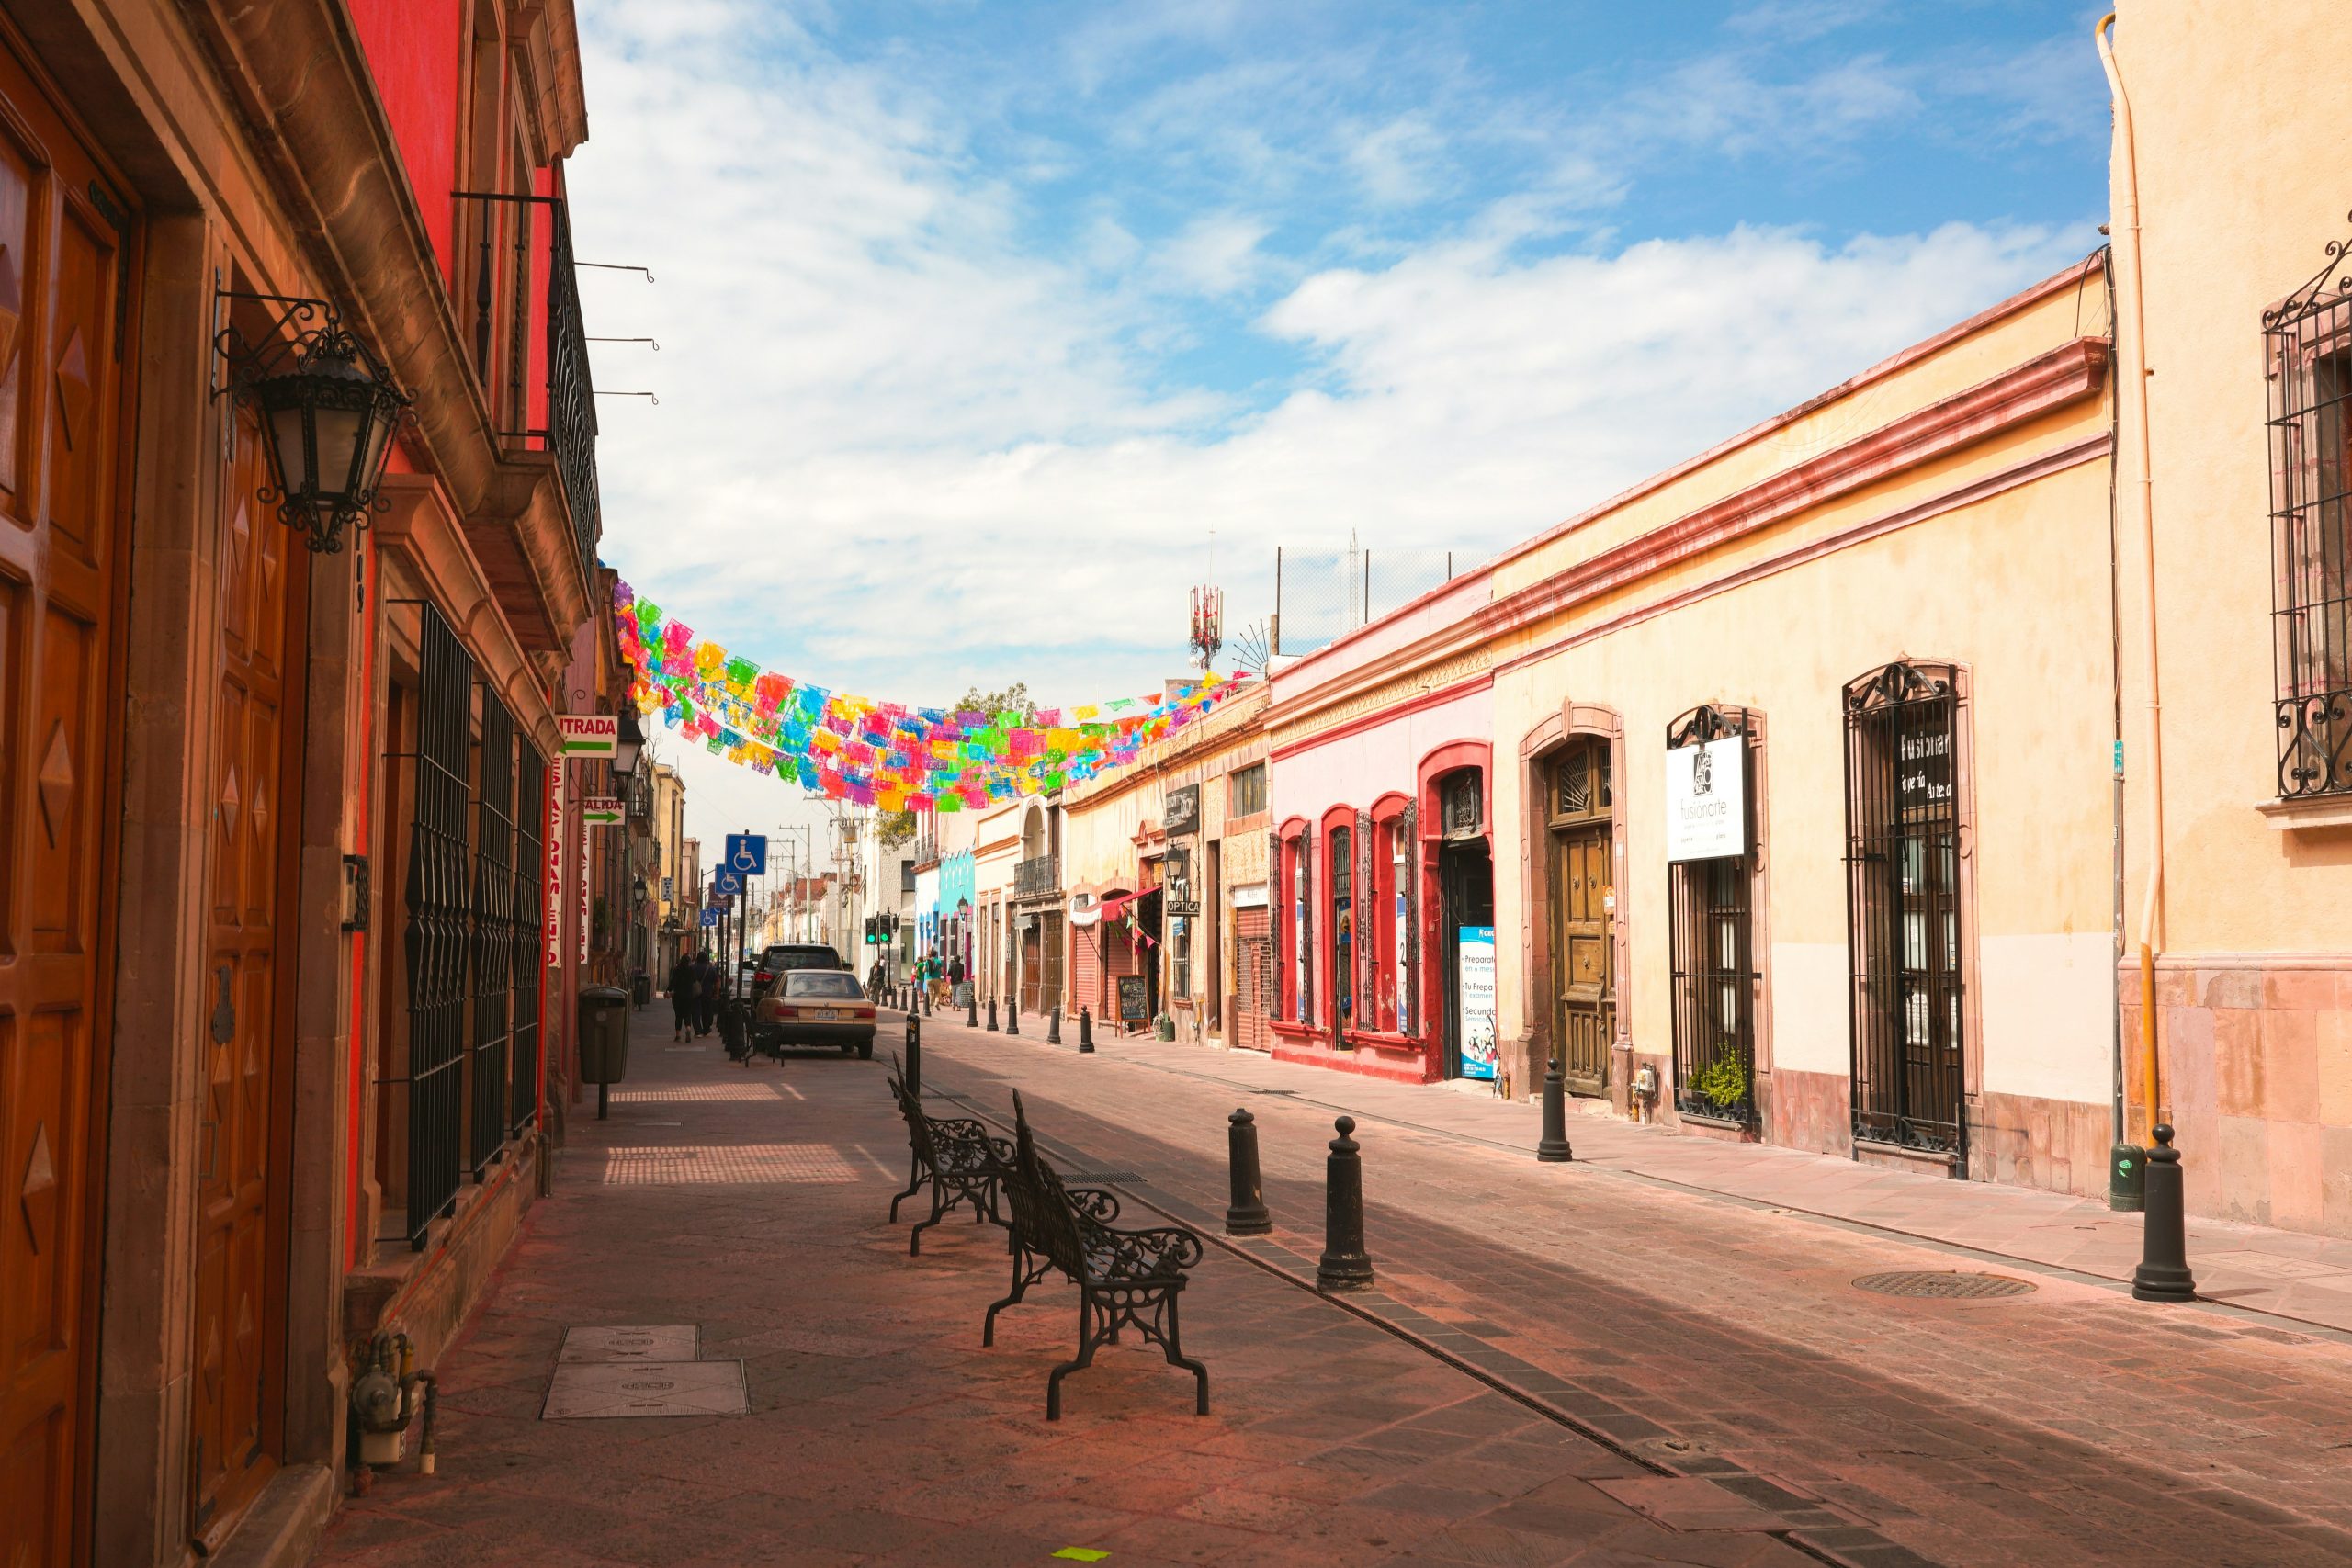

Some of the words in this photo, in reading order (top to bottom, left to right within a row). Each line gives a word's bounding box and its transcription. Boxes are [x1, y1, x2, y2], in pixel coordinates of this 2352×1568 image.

[560, 718, 616, 735] TRADA
[584, 799, 625, 810] ALIDA
[1167, 901, 1200, 912] OPTICA
[1464, 955, 1496, 964] Preparat
[1464, 982, 1472, 990] Tu
[1473, 983, 1493, 992] Prepa
